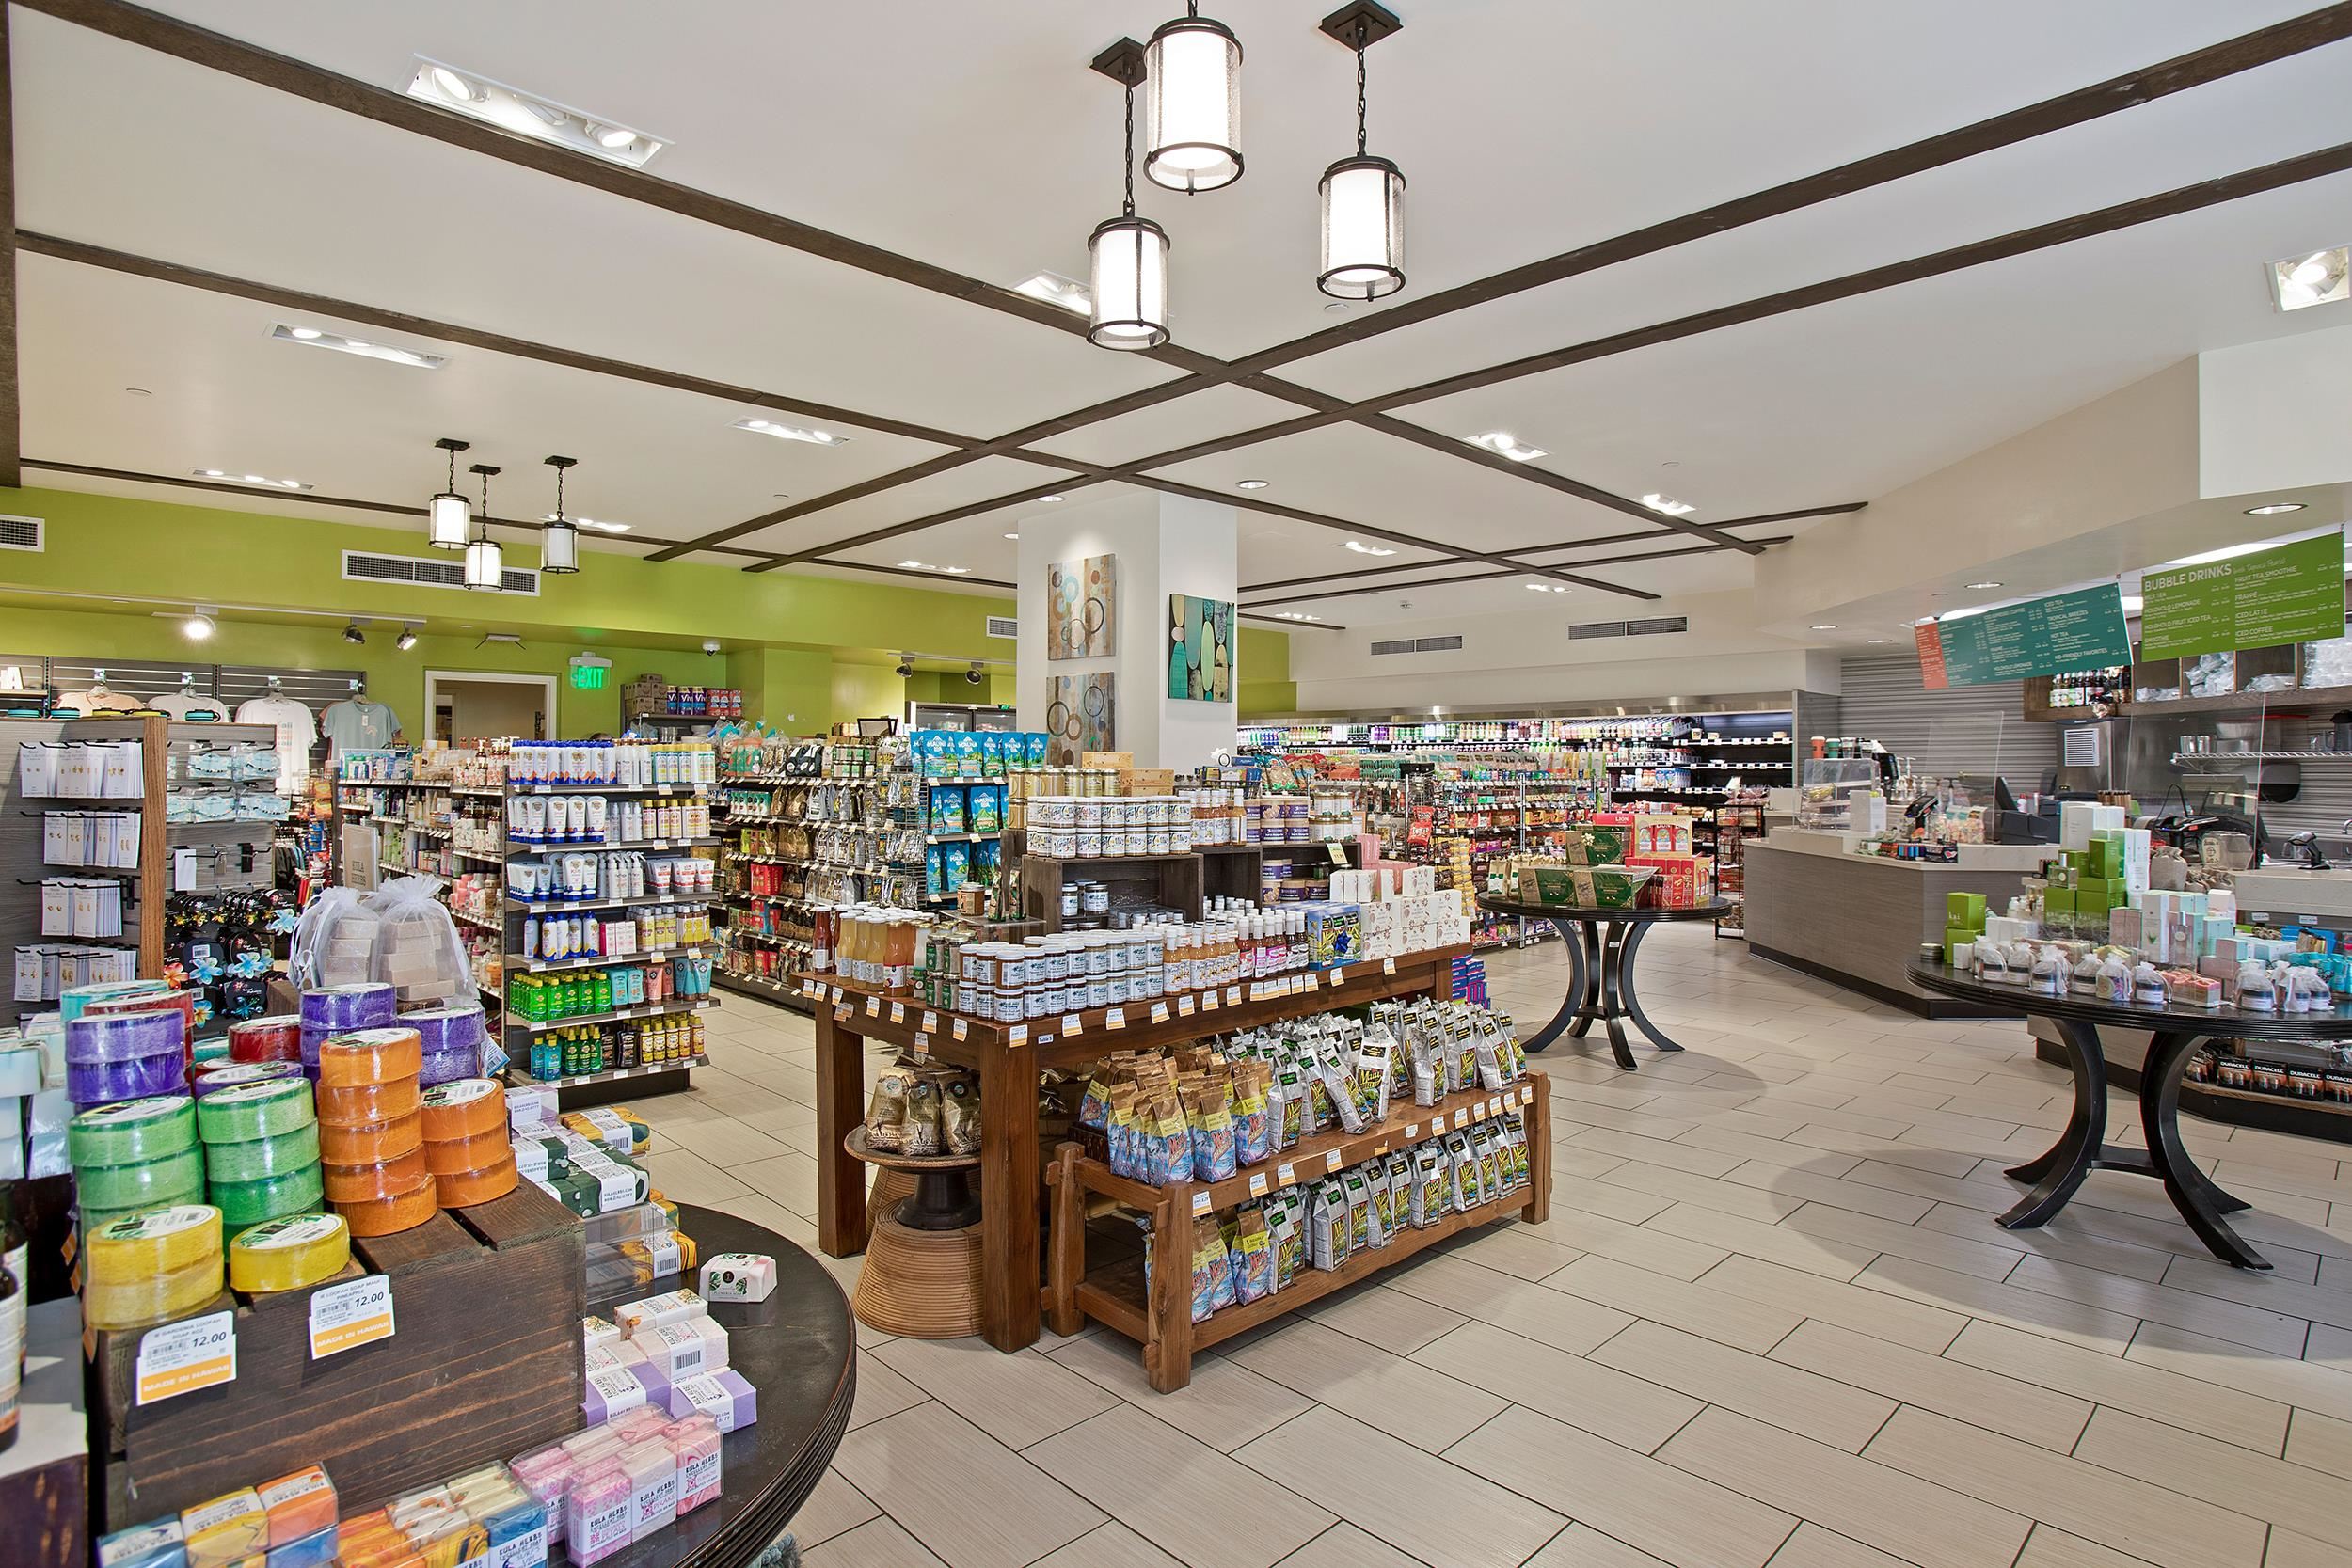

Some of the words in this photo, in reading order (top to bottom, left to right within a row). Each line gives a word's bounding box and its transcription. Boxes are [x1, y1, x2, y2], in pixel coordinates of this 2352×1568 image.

[2145, 573, 2186, 592] BUBBLE
[2188, 563, 2233, 583] DRINKS
[2265, 565, 2297, 577] SMOOTHIE
[2235, 610, 2249, 619] ICED
[2249, 609, 2268, 617] LATTE
[2249, 626, 2273, 635] COFFEE
[578, 668, 604, 688] EXIT
[2220, 1061, 2249, 1069] DURACELL
[2254, 1065, 2284, 1073] DURACELL
[2289, 1070, 2320, 1079] DURACELL
[355, 1291, 385, 1307] 12.00
[192, 1331, 226, 1348] 12.00
[317, 1333, 344, 1347] MADE
[357, 1322, 389, 1336] HAWAII
[143, 1378, 176, 1392] MADE
[178, 1373, 190, 1383] IN
[192, 1364, 230, 1378] HAWAII
[685, 1463, 699, 1473] KULA
[701, 1452, 718, 1465] HERBS
[640, 1491, 654, 1502] KULA
[657, 1480, 675, 1494] HERBS
[591, 1516, 605, 1527] KULA
[608, 1505, 628, 1519] HERBS
[499, 1544, 516, 1556] KULA
[519, 1532, 542, 1547] HERBS
